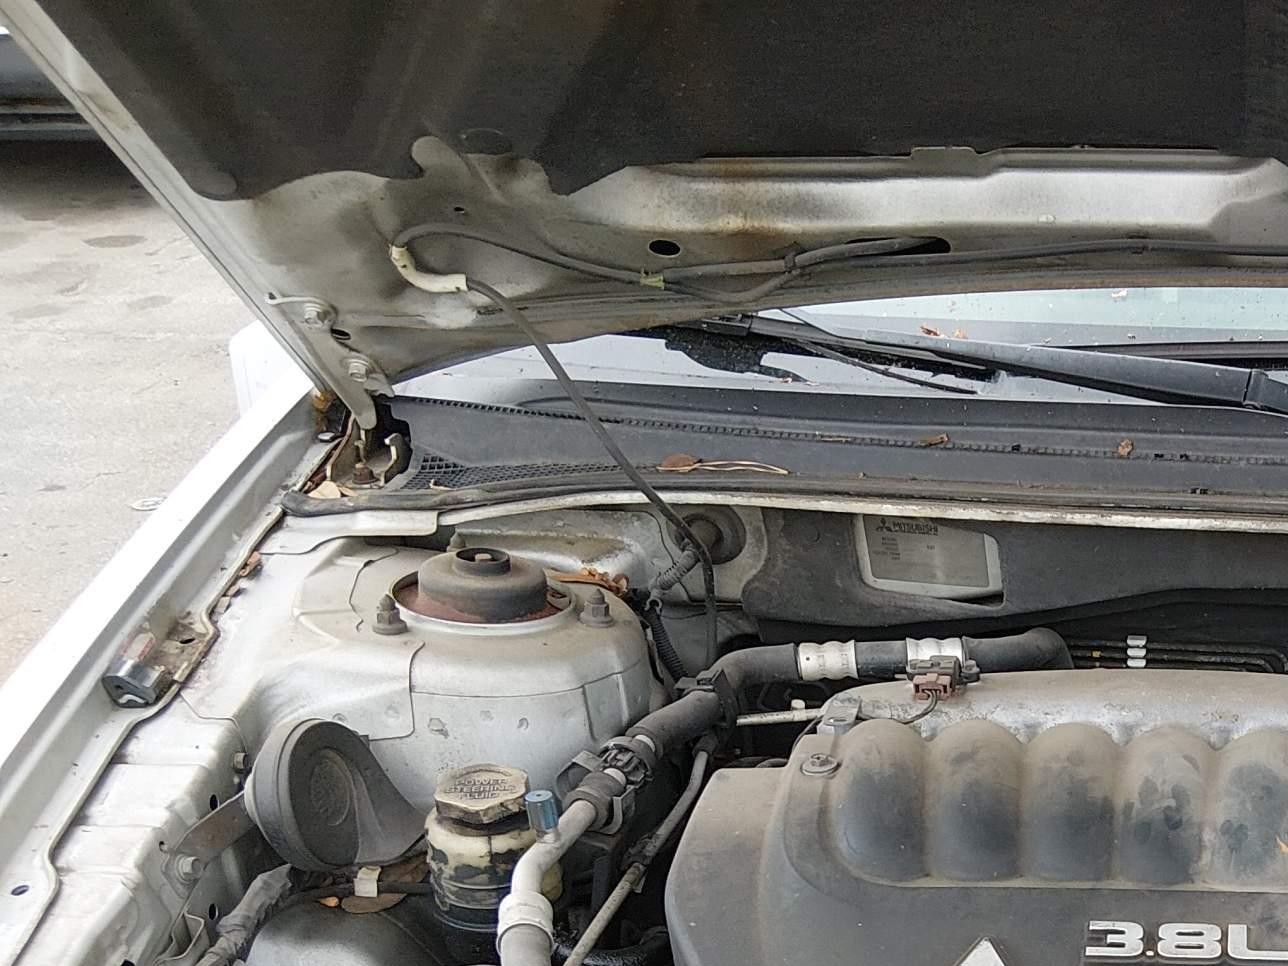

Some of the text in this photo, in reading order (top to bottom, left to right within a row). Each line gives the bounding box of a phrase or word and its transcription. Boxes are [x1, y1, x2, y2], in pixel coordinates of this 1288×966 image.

[892, 520, 939, 533] MITSUBISHI
[455, 778, 508, 787] POWER
[444, 785, 518, 794] STEERING
[459, 792, 500, 800] FLUID
